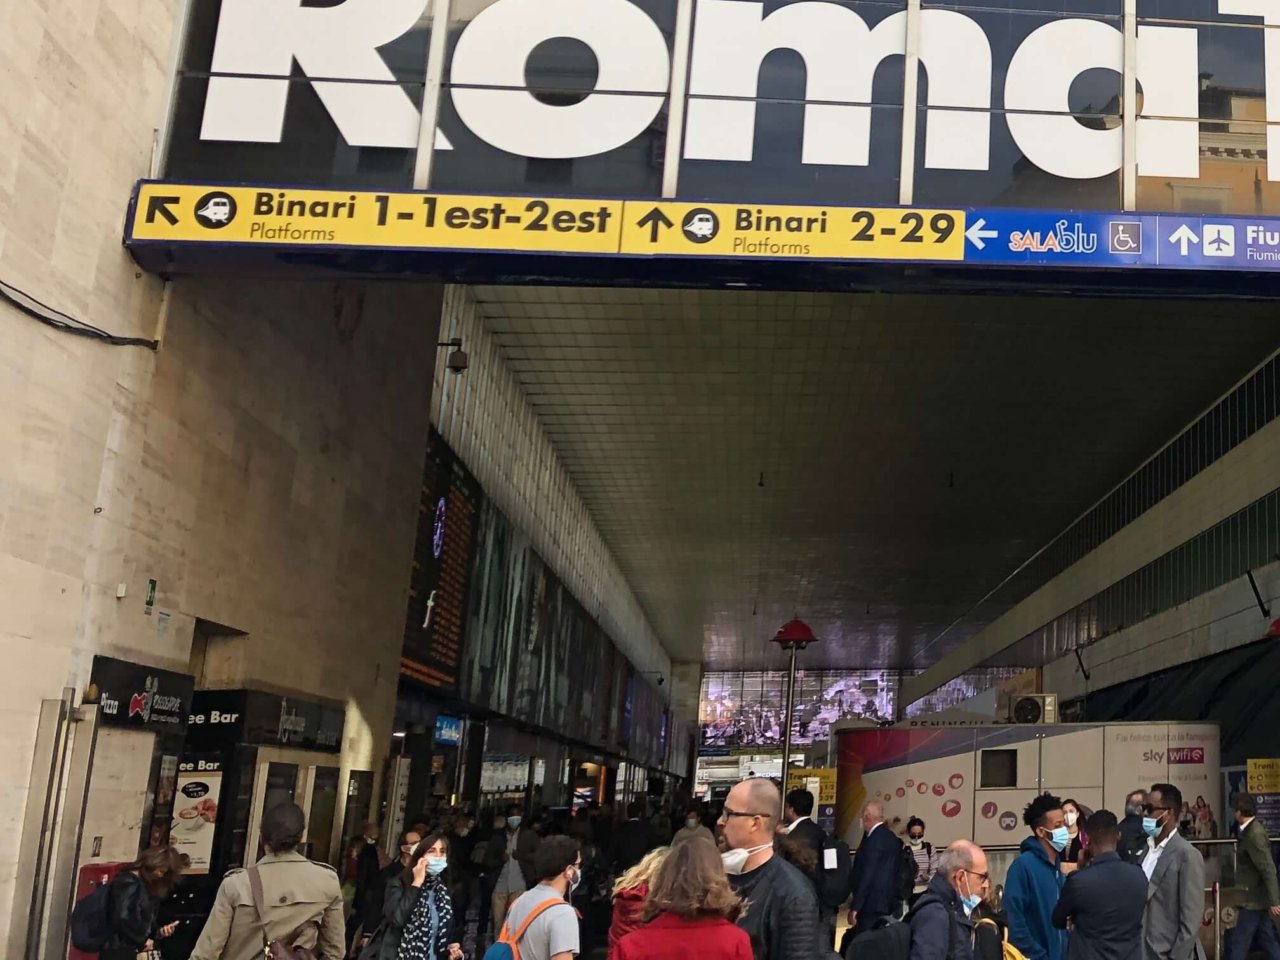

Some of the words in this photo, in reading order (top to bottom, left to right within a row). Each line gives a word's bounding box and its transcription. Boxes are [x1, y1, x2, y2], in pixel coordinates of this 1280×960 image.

[254, 192, 356, 218] Binari
[374, 194, 611, 234] 1-1est-2est
[250, 222, 335, 241] Platforms
[734, 209, 828, 233] Binari
[850, 210, 956, 244] 2-29
[733, 237, 810, 255] Platforms
[210, 710, 239, 724] Bar
[1143, 749, 1165, 763] sky
[1169, 749, 1191, 761] wifi
[197, 760, 220, 771] Bar
